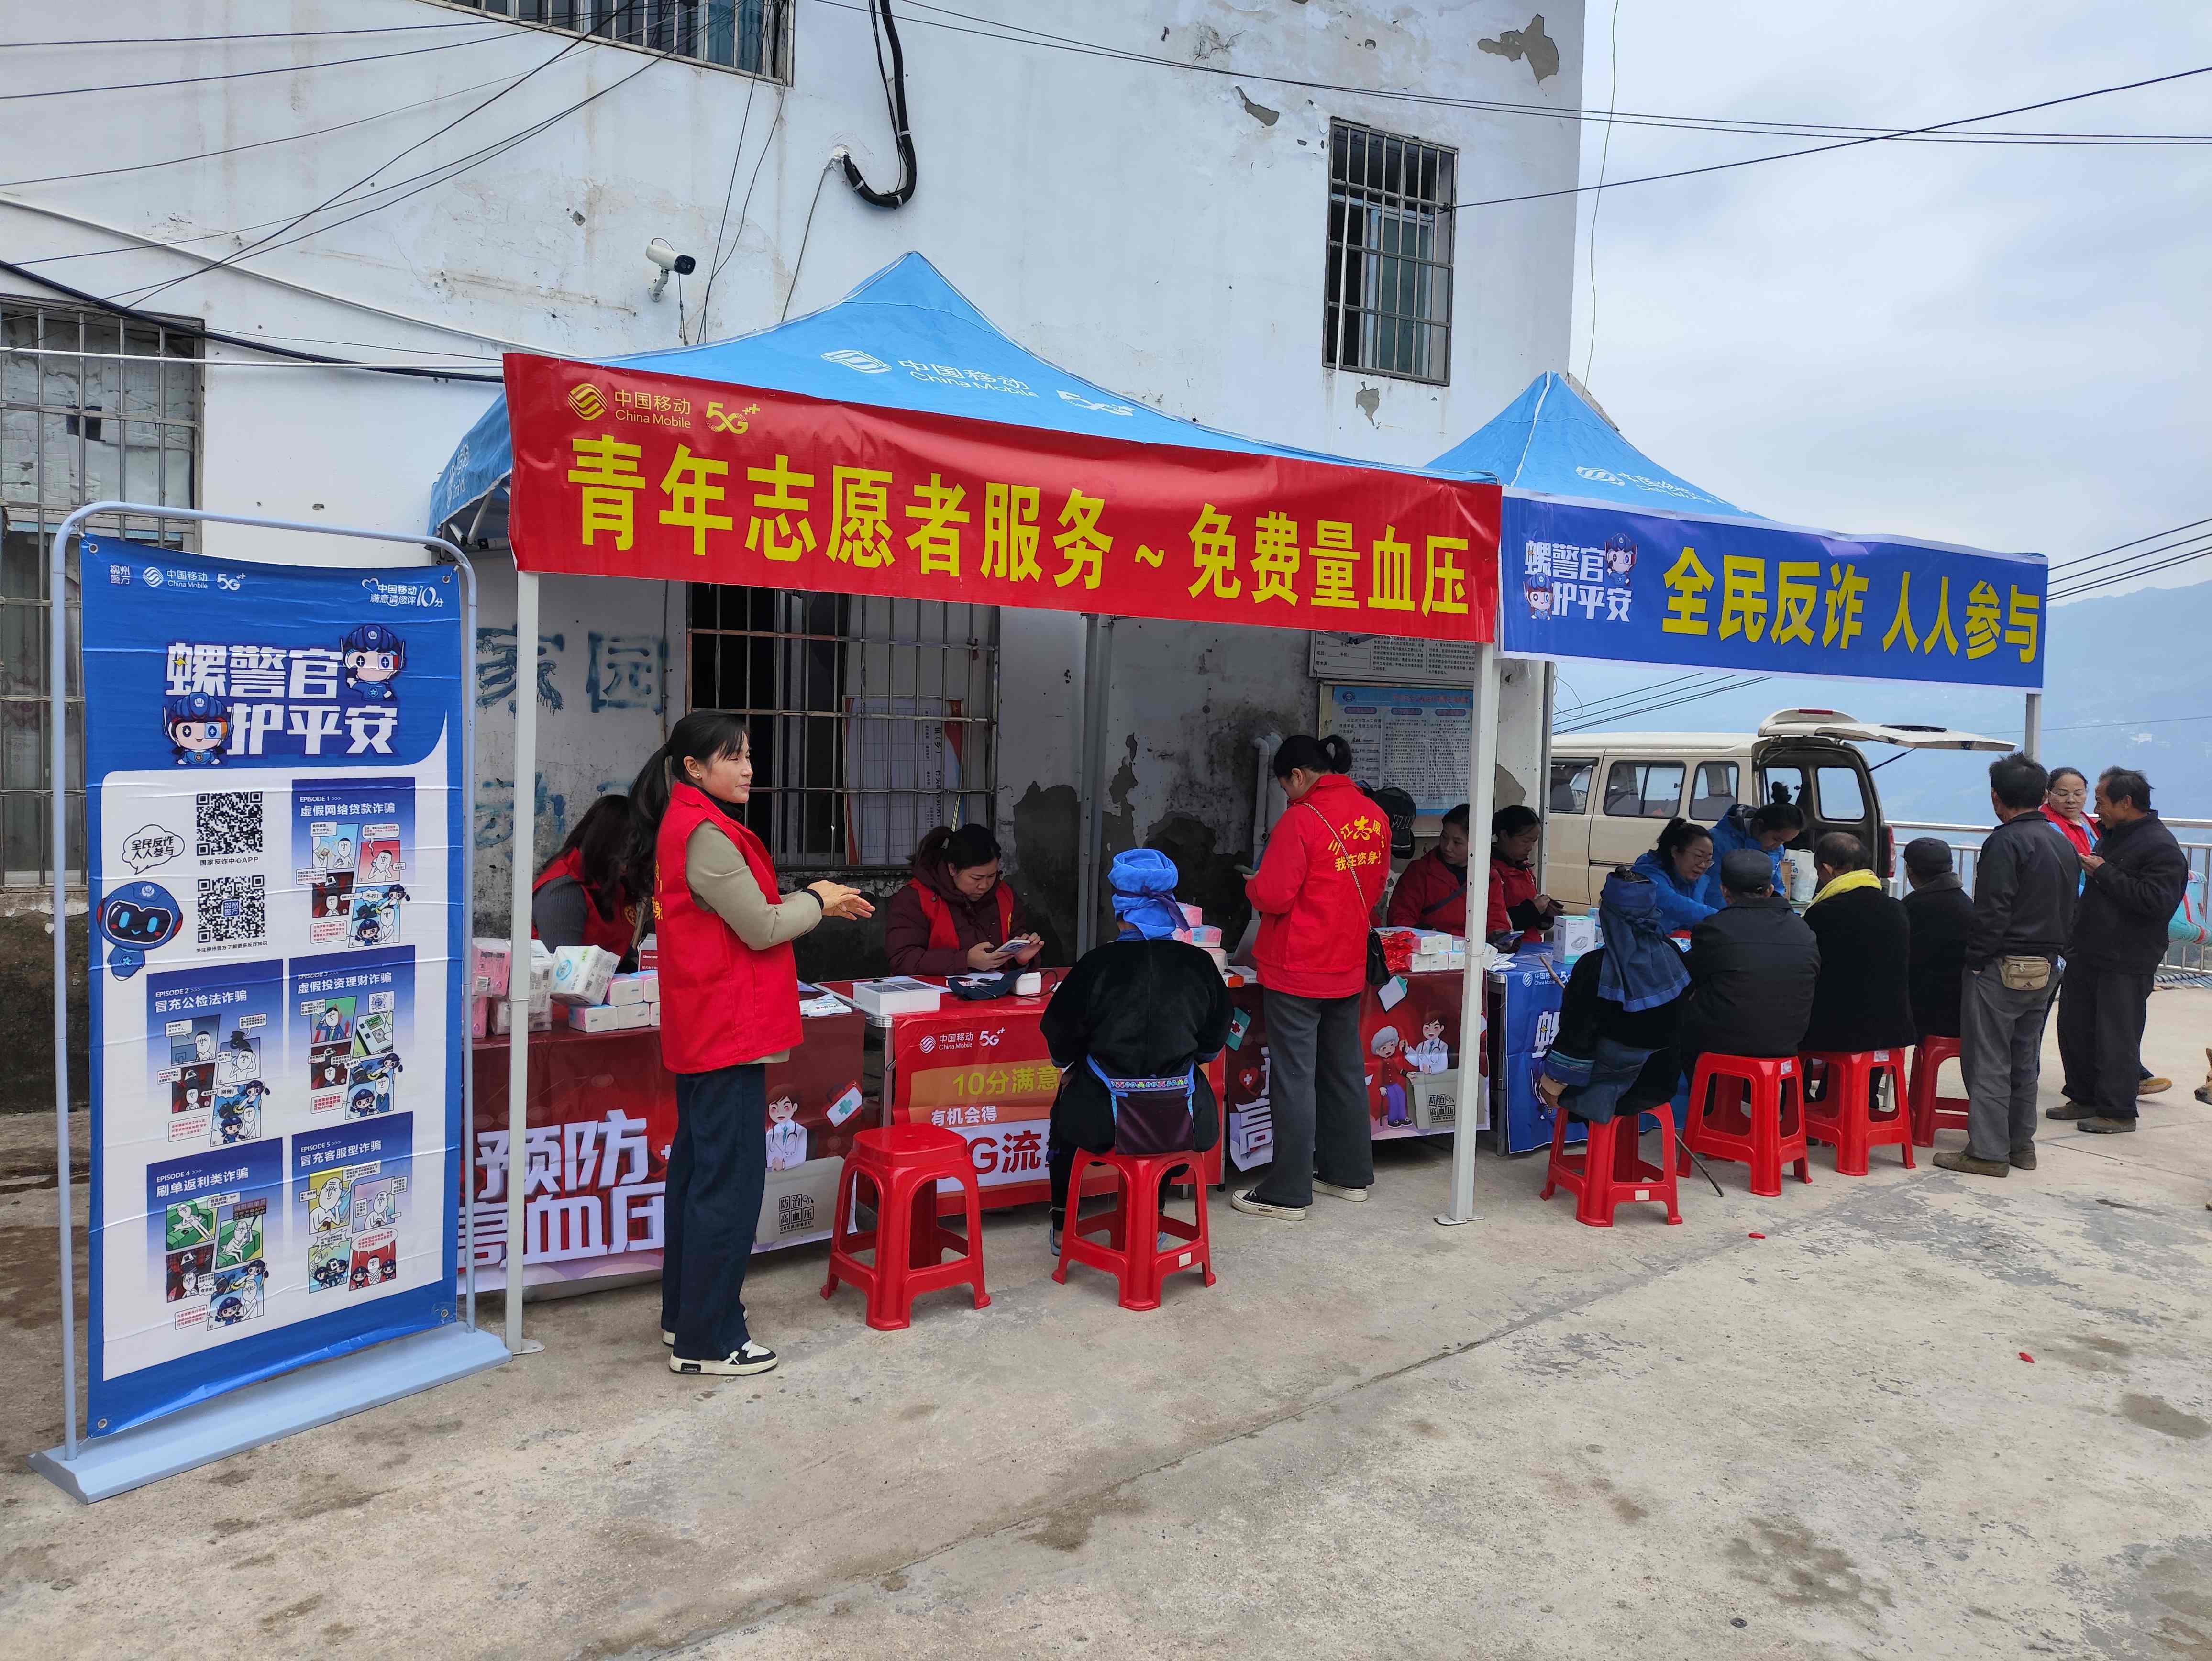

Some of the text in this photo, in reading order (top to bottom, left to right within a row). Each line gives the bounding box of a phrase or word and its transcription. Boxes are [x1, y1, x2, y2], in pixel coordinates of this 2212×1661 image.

[897, 359, 1030, 390] 中国移动
[909, 371, 971, 388] China
[614, 389, 690, 415] 中国移动
[615, 410, 691, 429] China Mobile
[1524, 539, 1605, 583] 螺警官
[166, 569, 208, 581] 中国移动
[378, 584, 417, 595] 中国移动
[1552, 581, 1632, 623] 护平安
[1662, 547, 2039, 664] 全民反诈 人人参与
[165, 642, 342, 699] 螺警官
[227, 703, 398, 756] 护平安
[300, 802, 396, 817] 虚假网络贷款诈骗
[131, 836, 174, 850] 全民反诈
[132, 846, 175, 860] 人人参与
[199, 856, 259, 866] 国家反诈中心APP
[1335, 850, 1381, 871] 我在您身
[298, 972, 392, 995] 虚假投资理财诈骗
[1534, 972, 1554, 980] 中国移
[155, 988, 184, 997] EPISODE
[155, 989, 247, 1013] 冒充公检法诈骗
[939, 1032, 973, 1043] 中国移动
[931, 1105, 997, 1126] 有机会得
[300, 1142, 325, 1152] EPISODE
[300, 1140, 382, 1167] 冒充客服型诈骗
[476, 1109, 649, 1199] 预防
[156, 1171, 184, 1183] EPISODE
[156, 1167, 249, 1197] 刷单返利类诈骗
[780, 1196, 801, 1210] 防治
[780, 1208, 812, 1225] 高血压
